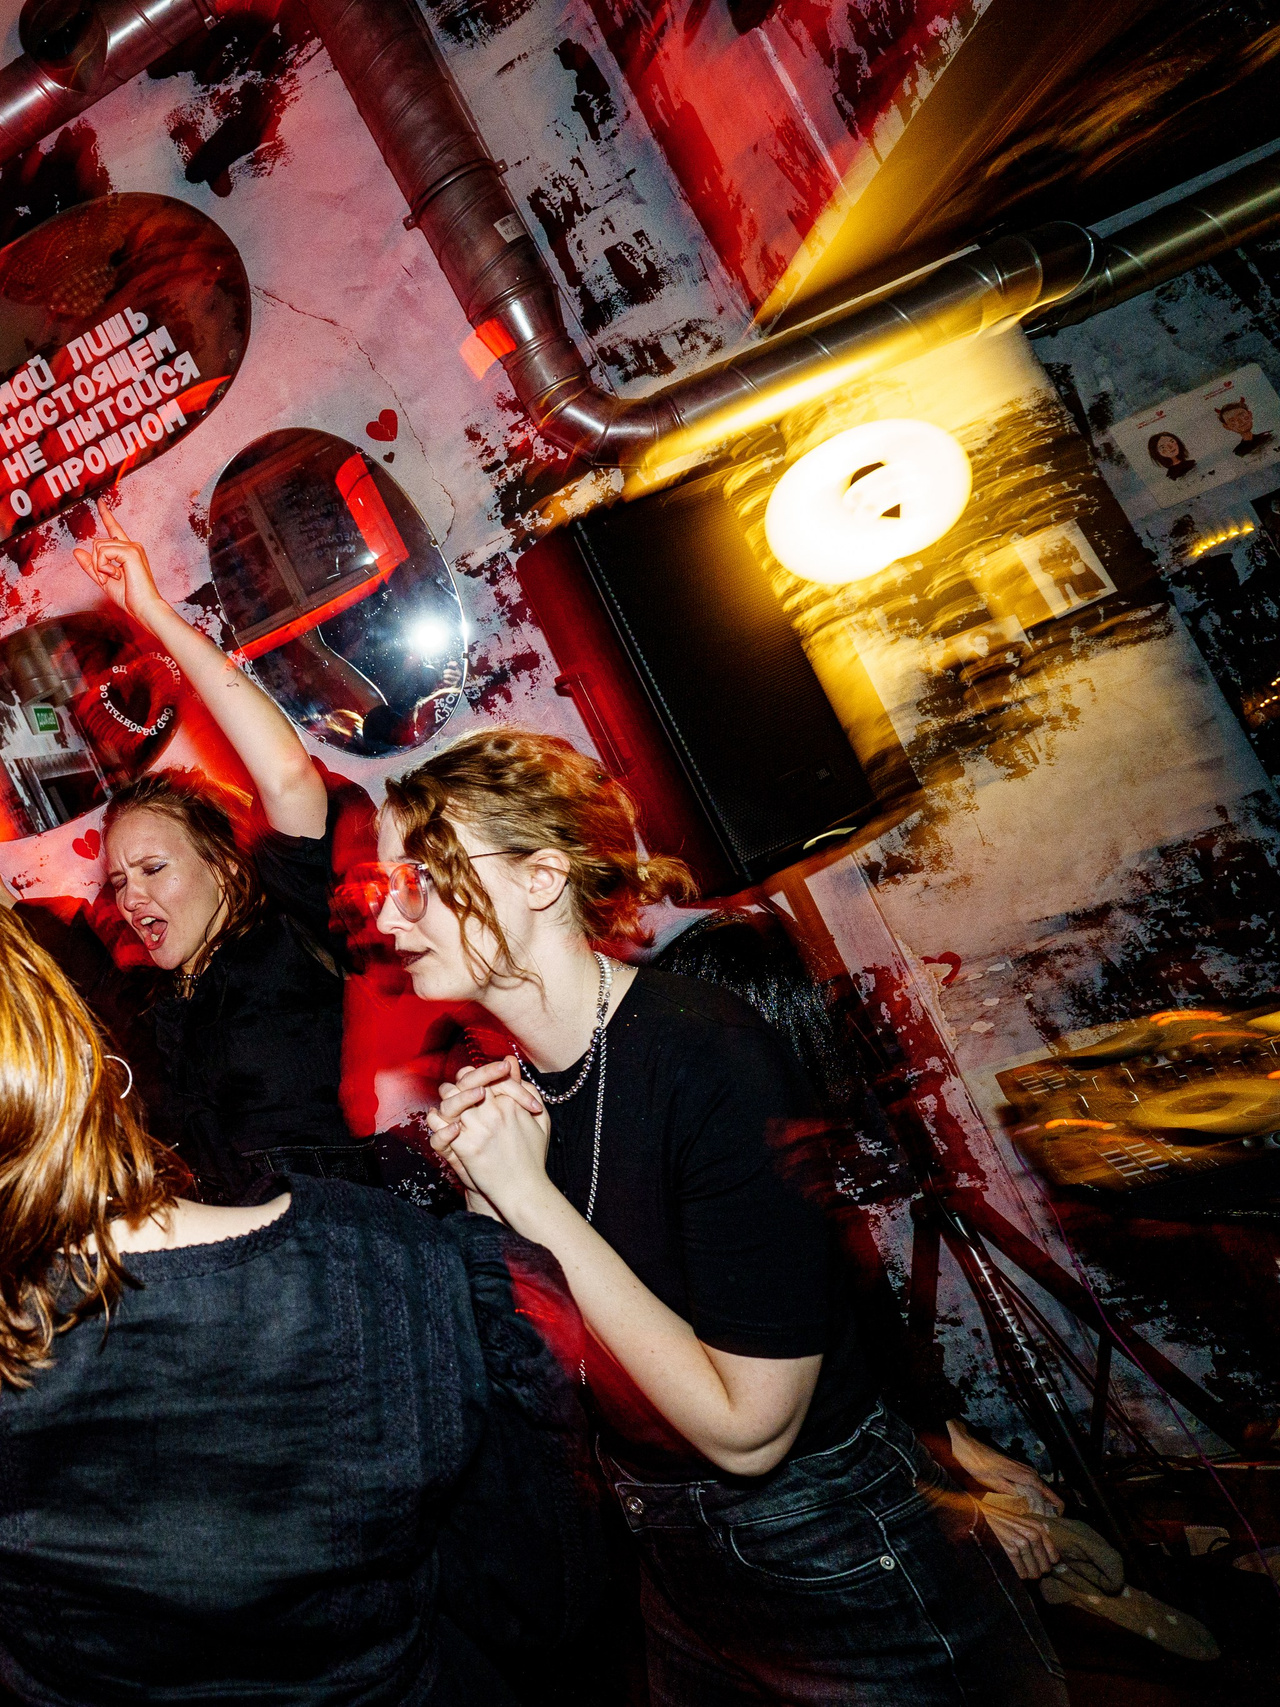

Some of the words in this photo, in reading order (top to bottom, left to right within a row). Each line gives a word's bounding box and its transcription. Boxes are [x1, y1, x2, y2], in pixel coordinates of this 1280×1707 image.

[66, 306, 149, 371] ЛИШЬ
[2, 441, 48, 485] НЕ
[56, 350, 201, 452] ПЫТАЙСЯ
[9, 489, 33, 517] О
[43, 399, 188, 498] ПРОШЛОМ
[103, 700, 158, 736] разбитых
[156, 707, 174, 729] бар
[978, 1275, 1042, 1390] SUPPORT
